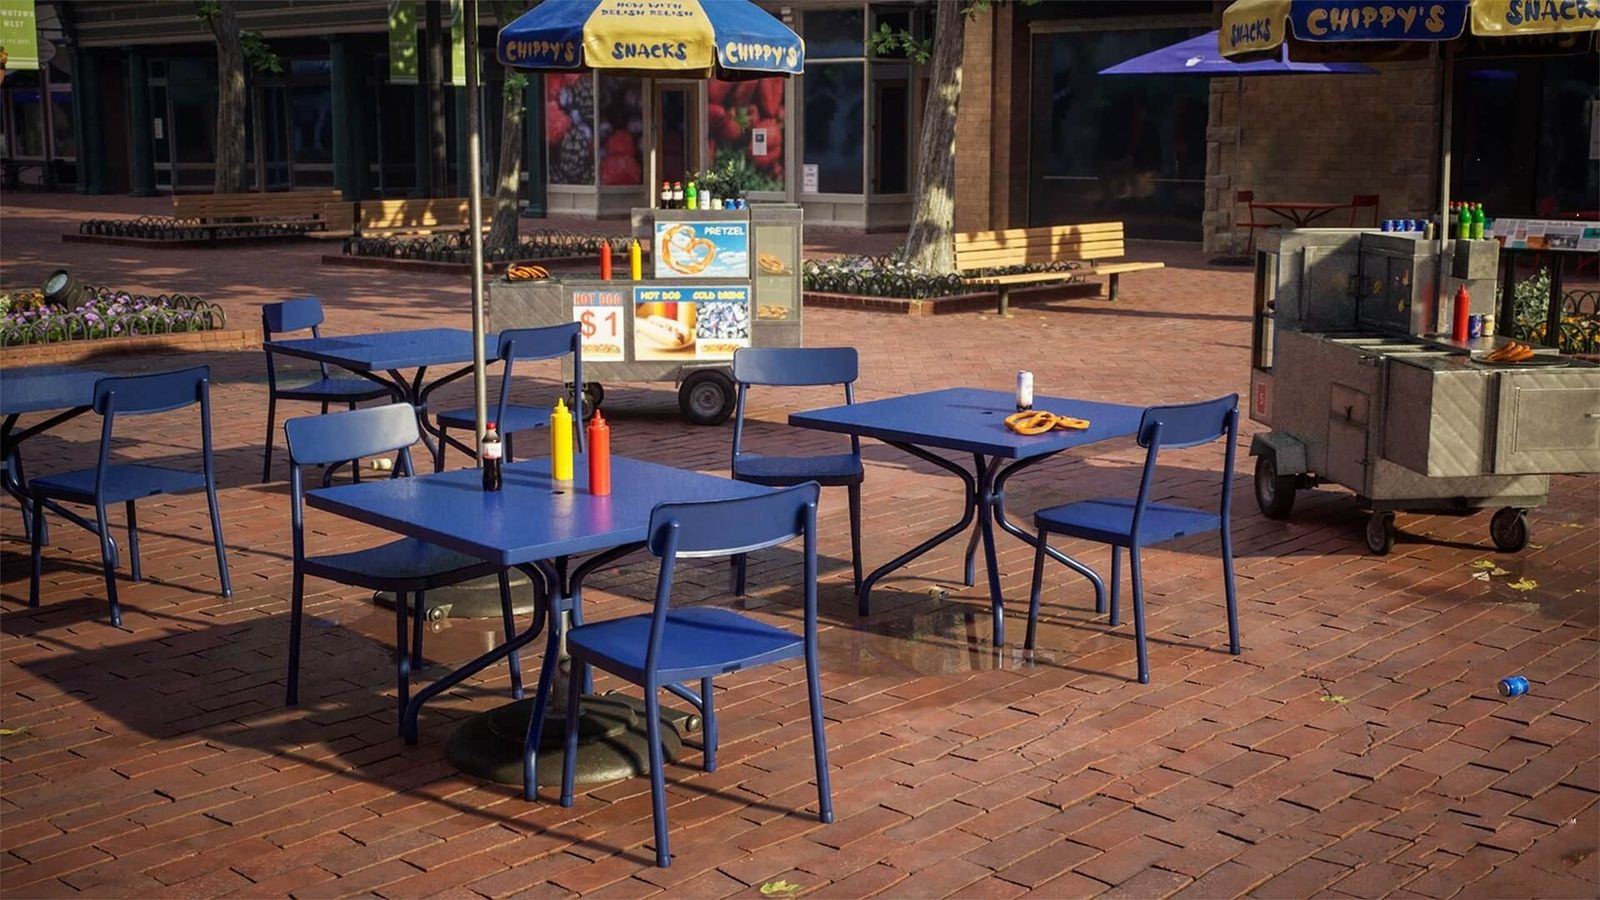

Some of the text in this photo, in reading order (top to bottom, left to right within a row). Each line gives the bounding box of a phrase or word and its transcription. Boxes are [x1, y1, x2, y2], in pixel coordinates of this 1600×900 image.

[1306, 7, 1445, 35] CHIPPY'S
[1505, 0, 1600, 25] SNACK
[1231, 17, 1271, 47] SNACKS
[506, 41, 574, 62] CHIPPY'S
[611, 42, 688, 61] SNACKS
[725, 40, 798, 68] CHIPPY'S
[704, 226, 746, 236] PRETZEL
[574, 292, 623, 305] HOT DOG
[641, 291, 682, 300] HOT DOG
[692, 291, 716, 300] COLD
